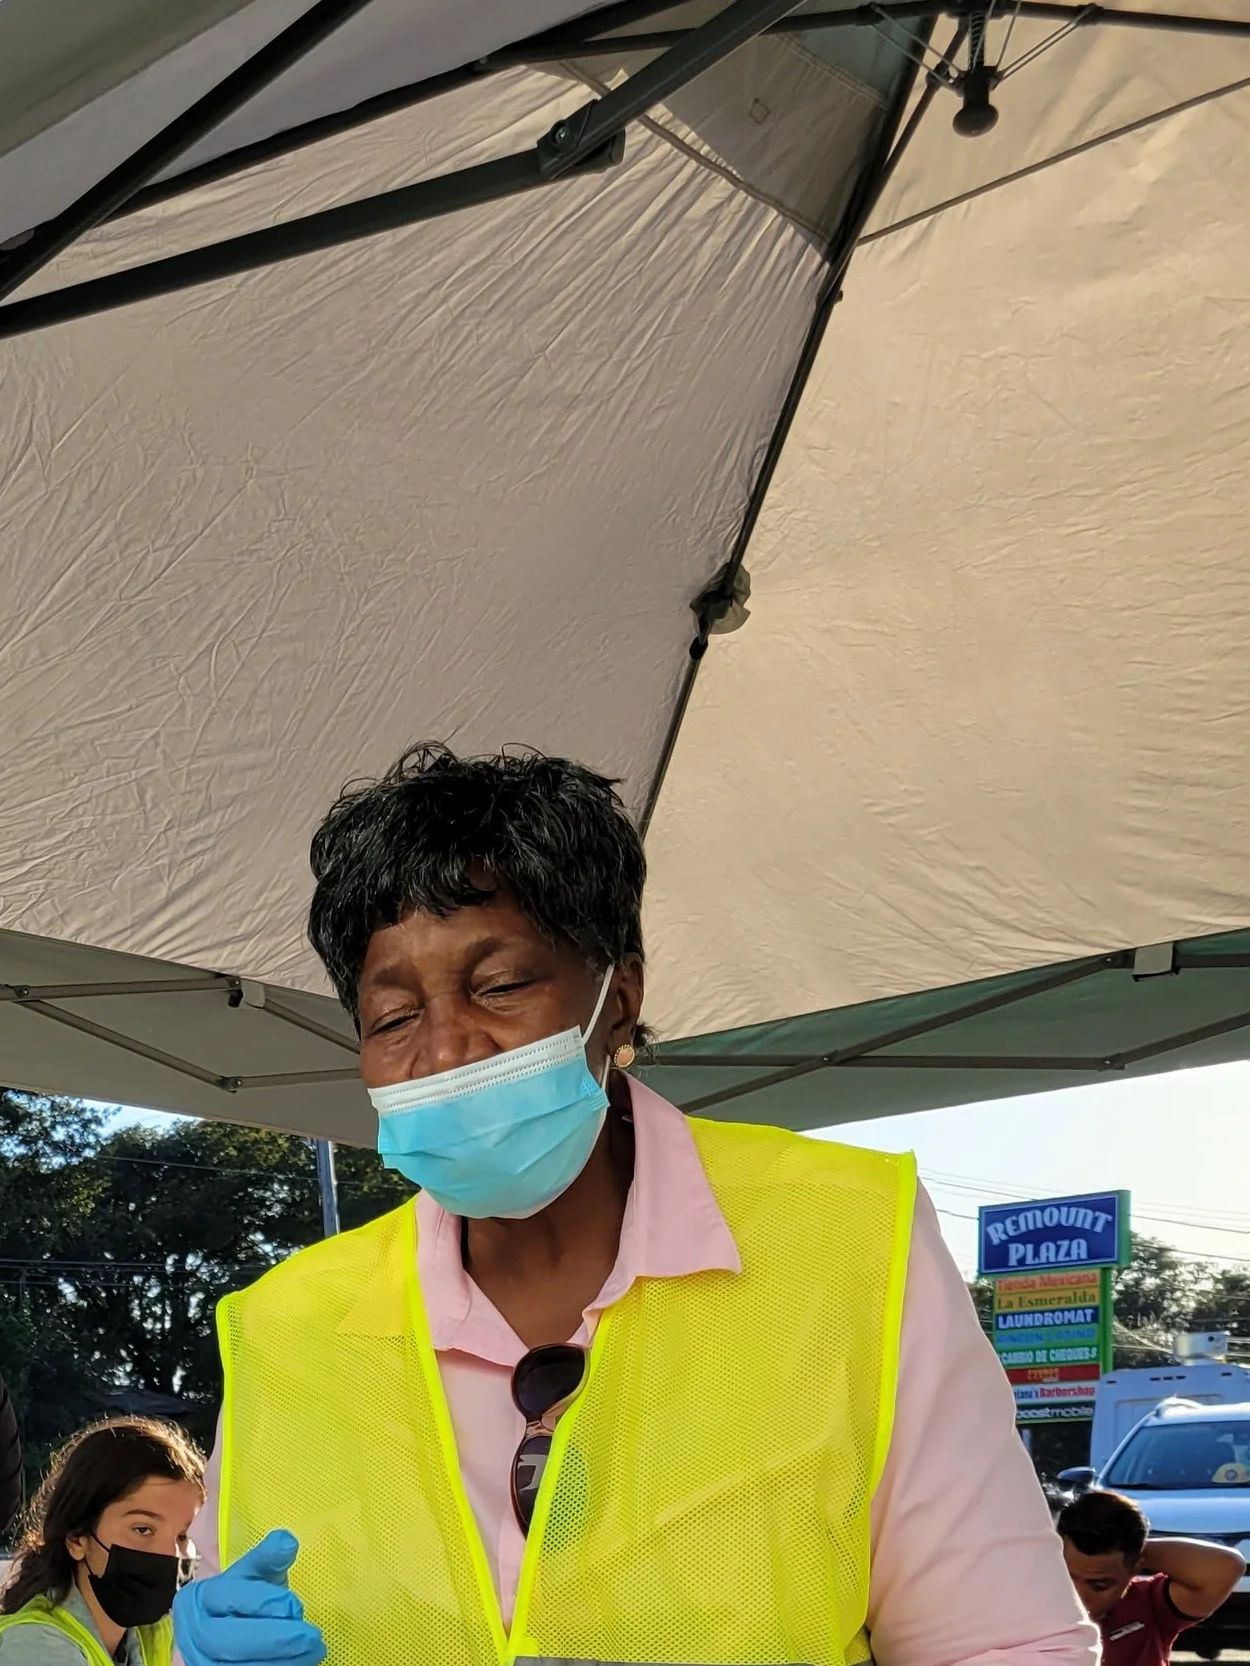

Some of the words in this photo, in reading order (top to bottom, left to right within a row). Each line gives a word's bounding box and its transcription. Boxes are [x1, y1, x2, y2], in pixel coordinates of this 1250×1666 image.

[986, 1206, 1113, 1245] REMOUNT
[1008, 1238, 1088, 1266] PLAZA
[1018, 1291, 1095, 1308] Esmeralda
[998, 1308, 1094, 1329] LAUNDROMAT
